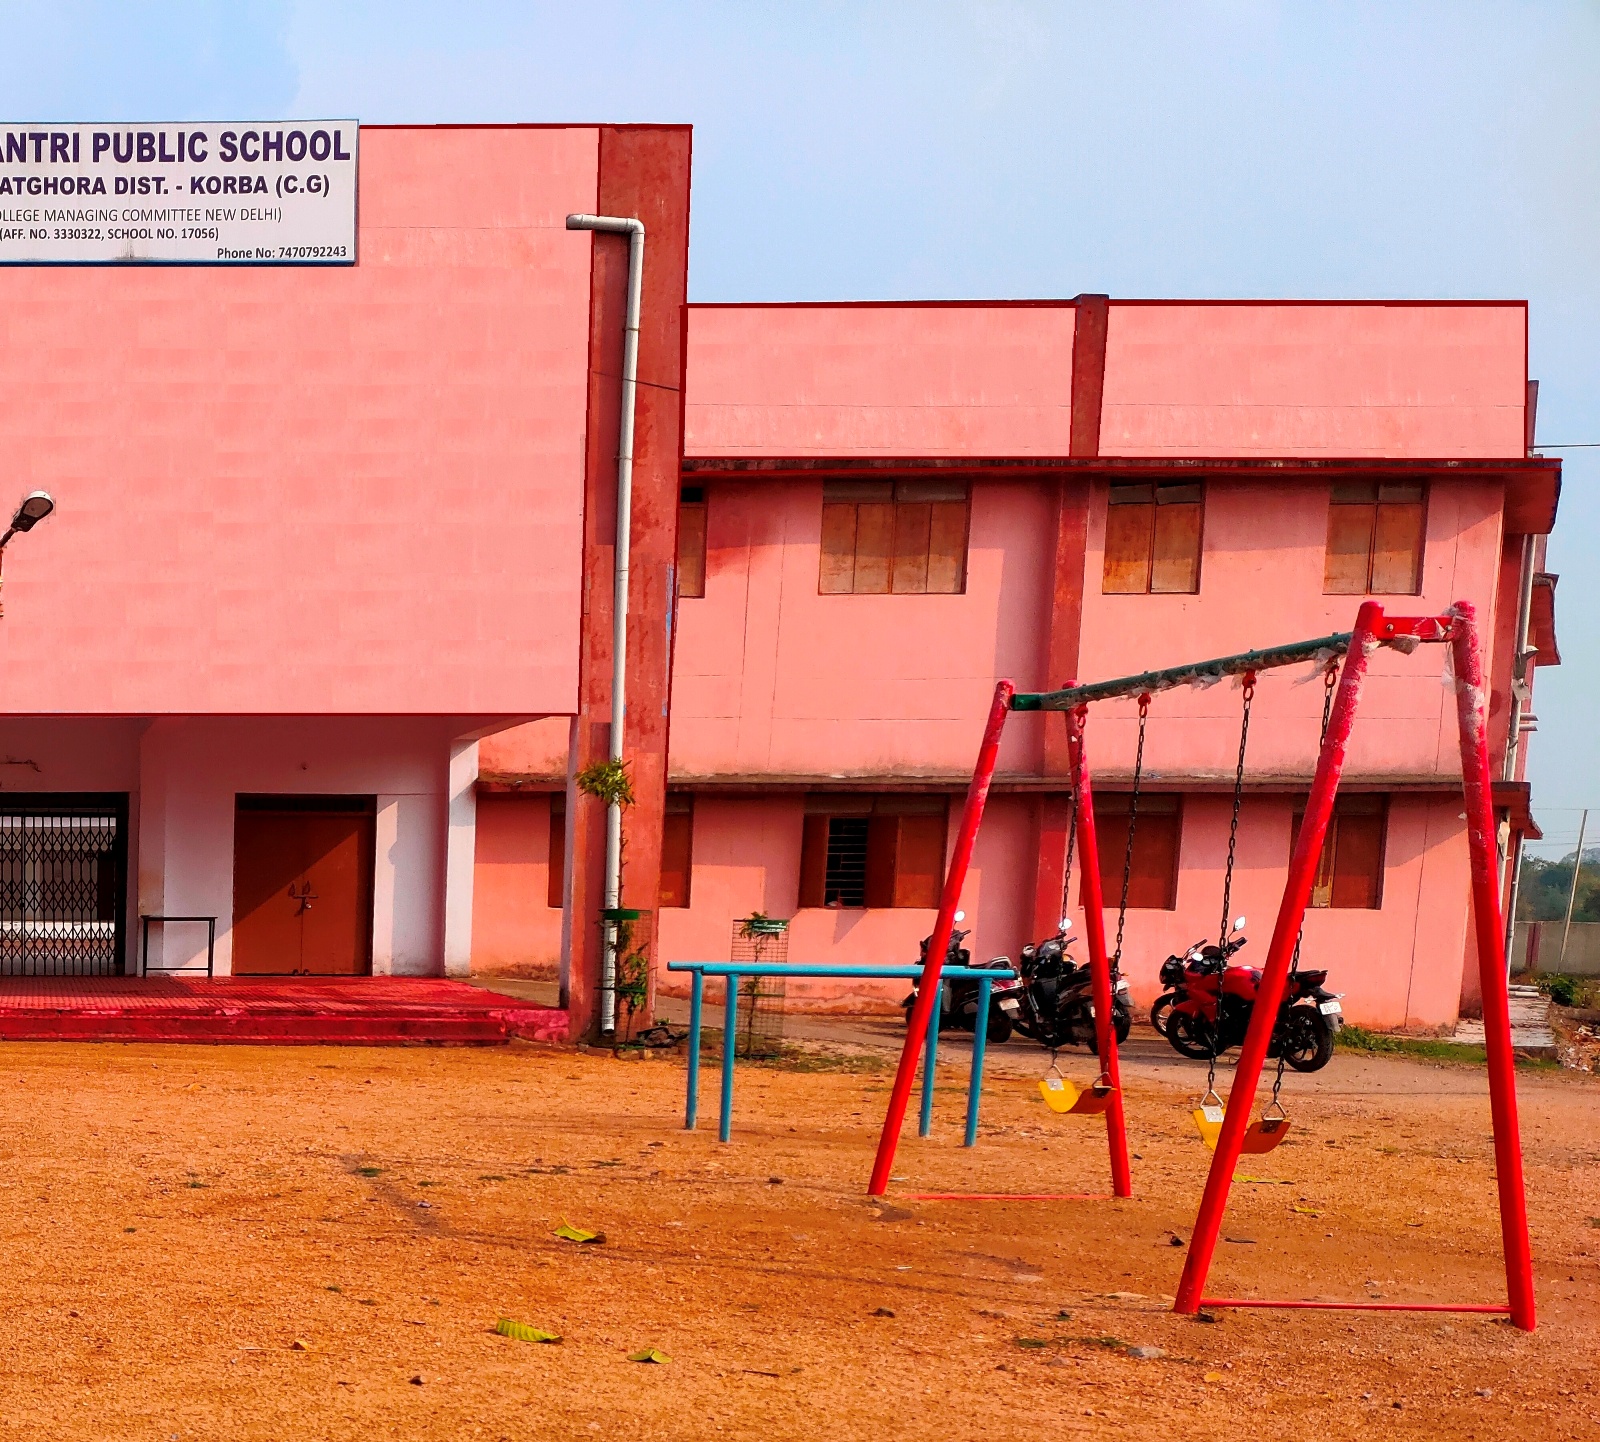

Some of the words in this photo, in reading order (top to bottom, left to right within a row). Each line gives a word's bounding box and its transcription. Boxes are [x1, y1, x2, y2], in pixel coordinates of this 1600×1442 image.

[93, 132, 208, 163] PUBLIC
[219, 130, 350, 162] SCHOOL
[115, 177, 168, 195] DIST.
[191, 176, 268, 194] KORBA
[276, 175, 329, 198] (C.G)
[44, 209, 118, 222] MANAGING
[121, 208, 202, 222] COMMITTEE
[205, 208, 237, 222] NEW
[240, 206, 282, 224] DELHI)
[0, 227, 26, 242] (AFF.
[29, 228, 51, 240] NO.
[53, 228, 105, 242] 3330322,
[107, 228, 154, 240] SCHOOL
[156, 228, 178, 240] NO.
[181, 226, 219, 242] 17056)
[217, 246, 253, 259] Phone
[255, 246, 276, 259] No:
[278, 245, 347, 259] 7470792243
